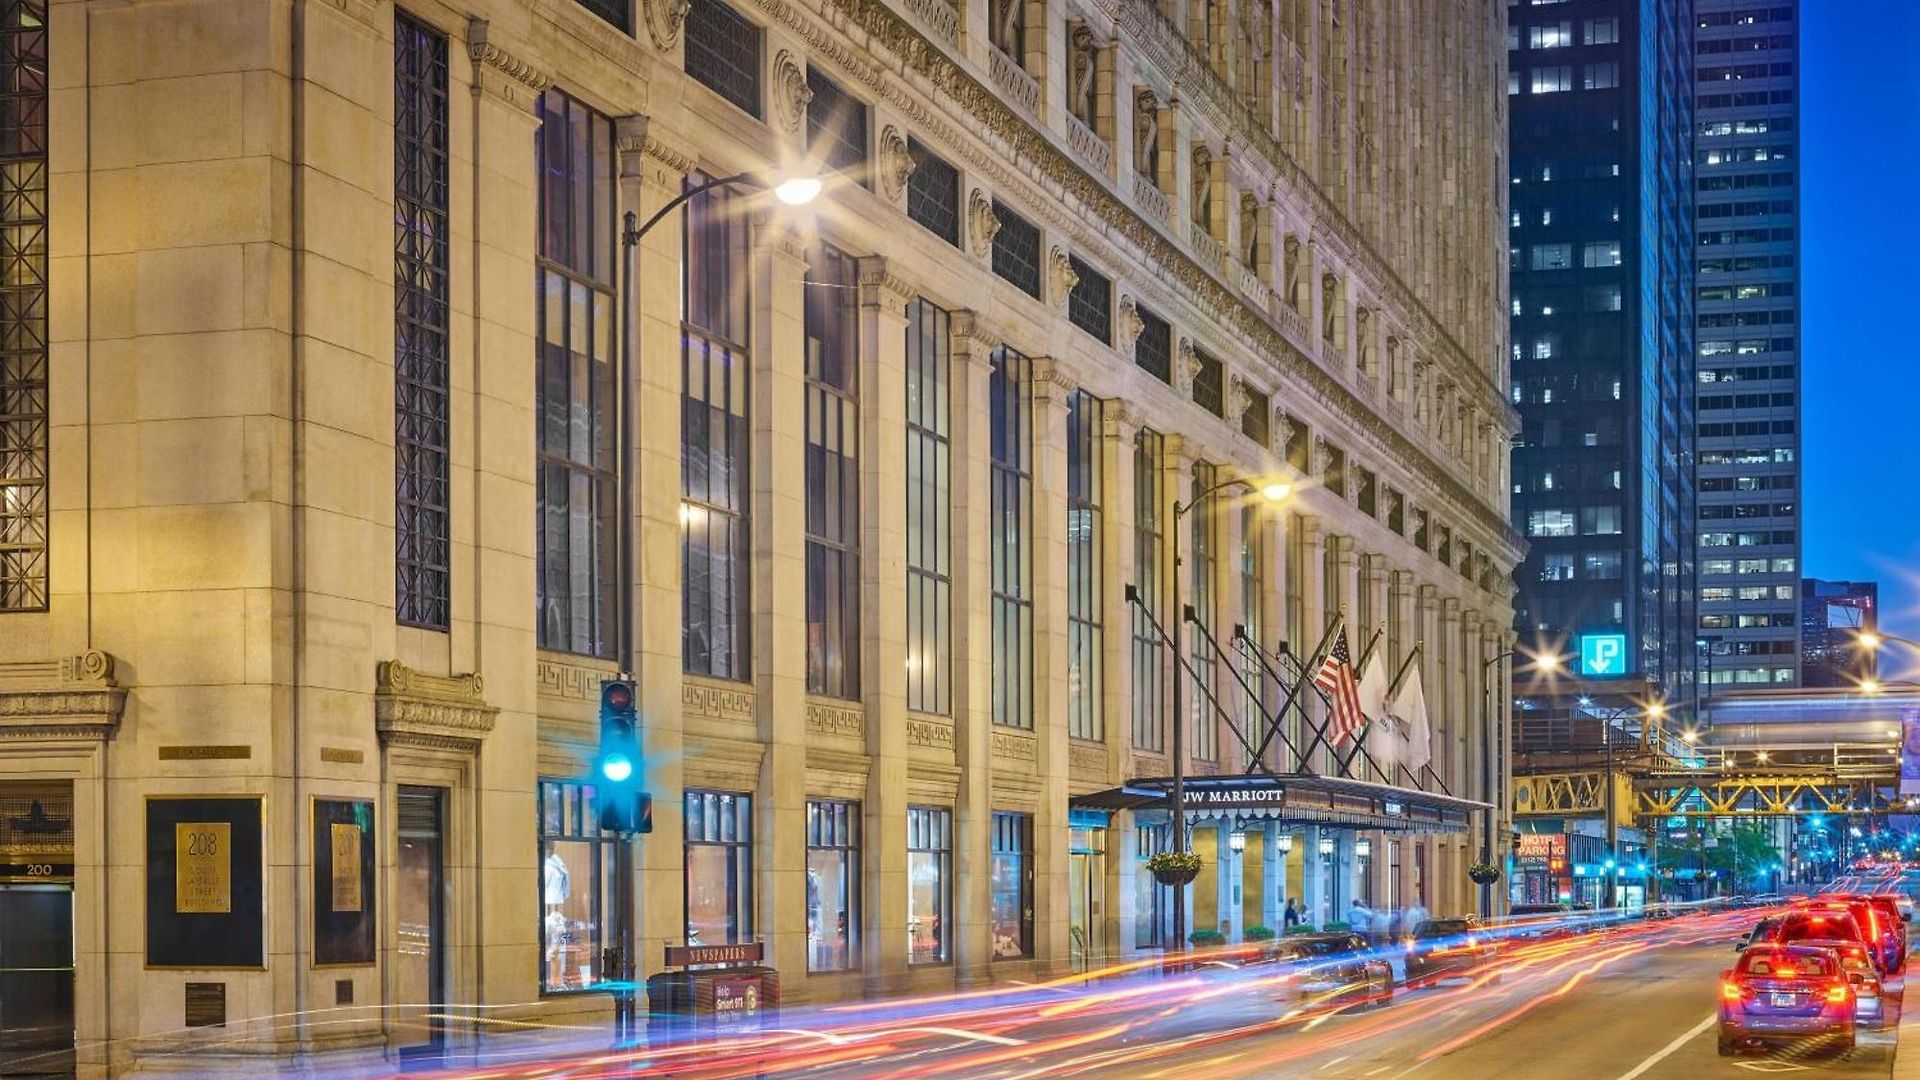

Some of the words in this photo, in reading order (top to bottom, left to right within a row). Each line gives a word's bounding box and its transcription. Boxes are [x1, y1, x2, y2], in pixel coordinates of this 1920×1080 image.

[1183, 791, 1204, 802] JW
[1209, 790, 1283, 802] MARRIOTT
[189, 832, 217, 856] 208
[1518, 846, 1565, 856] PARKING
[27, 864, 52, 875] 200
[690, 946, 746, 961] NEWSPAPERS
